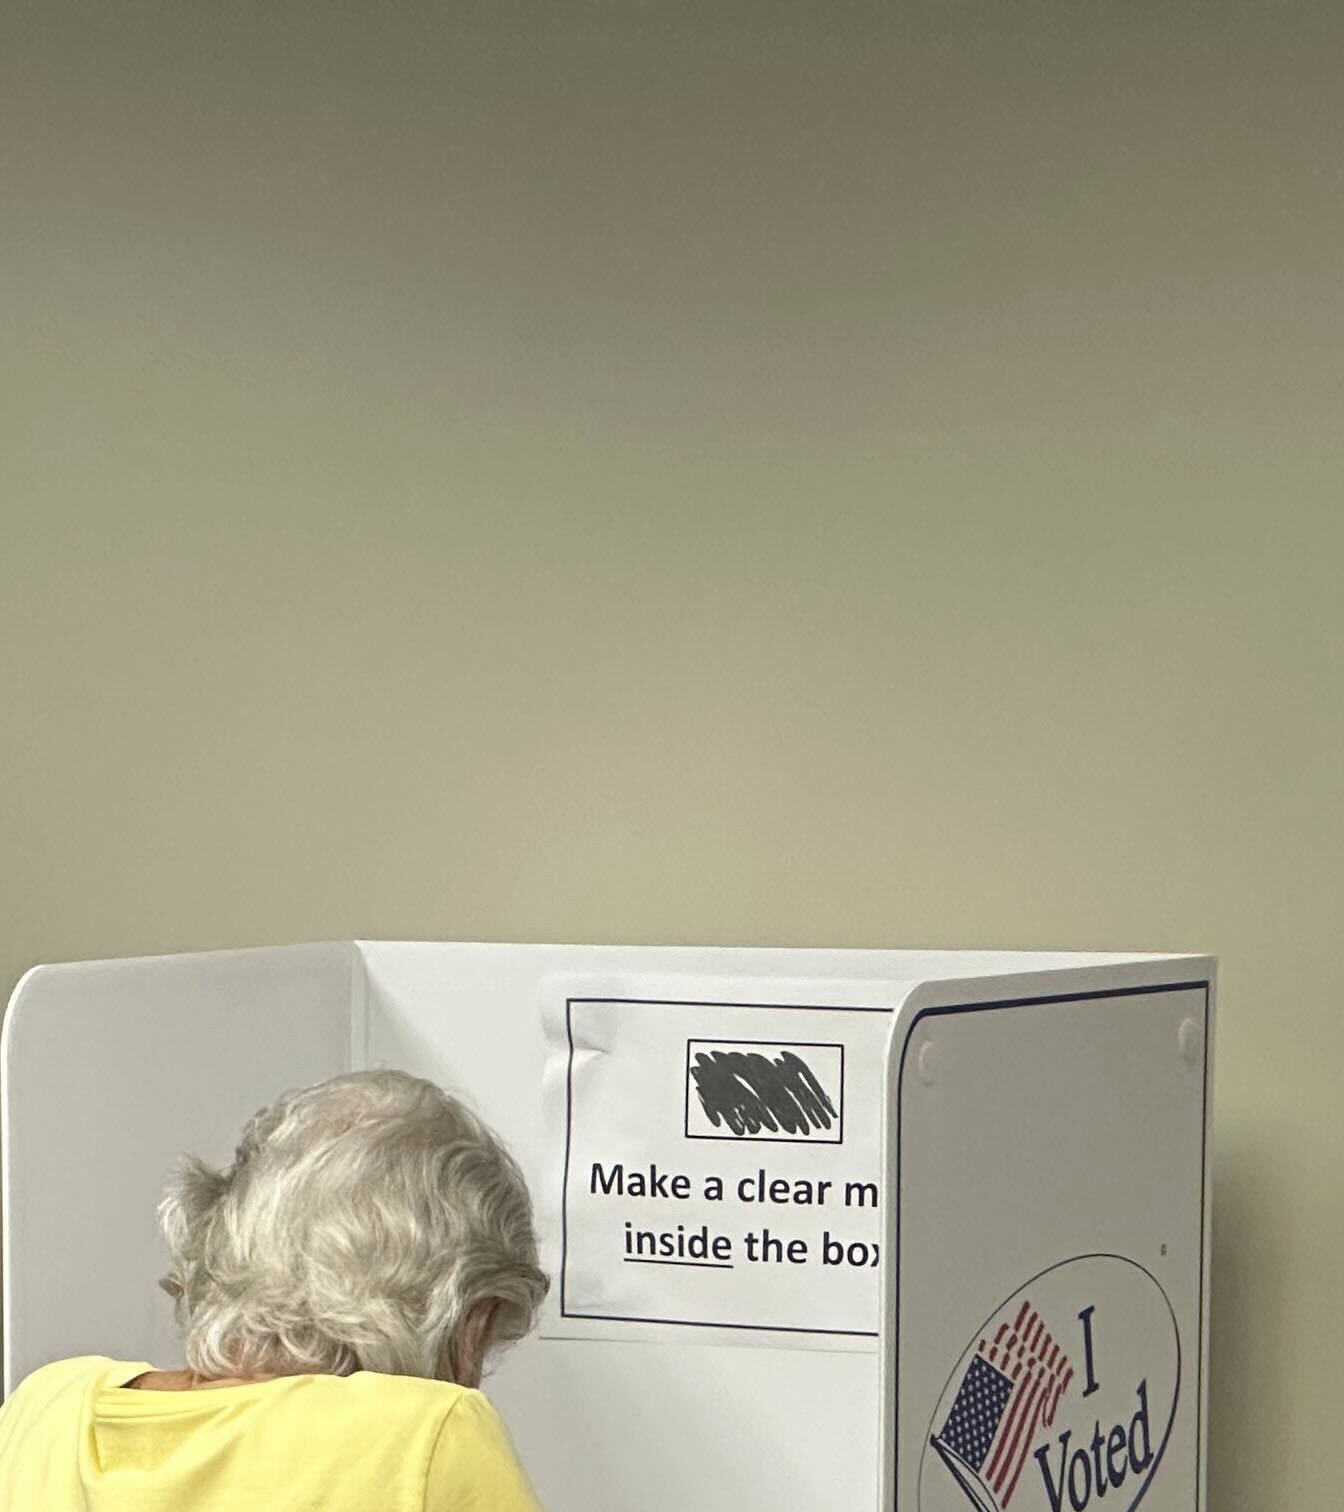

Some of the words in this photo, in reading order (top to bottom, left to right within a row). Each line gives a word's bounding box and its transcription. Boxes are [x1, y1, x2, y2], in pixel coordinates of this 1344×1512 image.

[590, 1162, 691, 1201] Make
[704, 1176, 724, 1201] a
[737, 1169, 832, 1206] clear
[624, 1222, 731, 1261] inside
[744, 1228, 807, 1264] the
[1077, 1305, 1100, 1398] I
